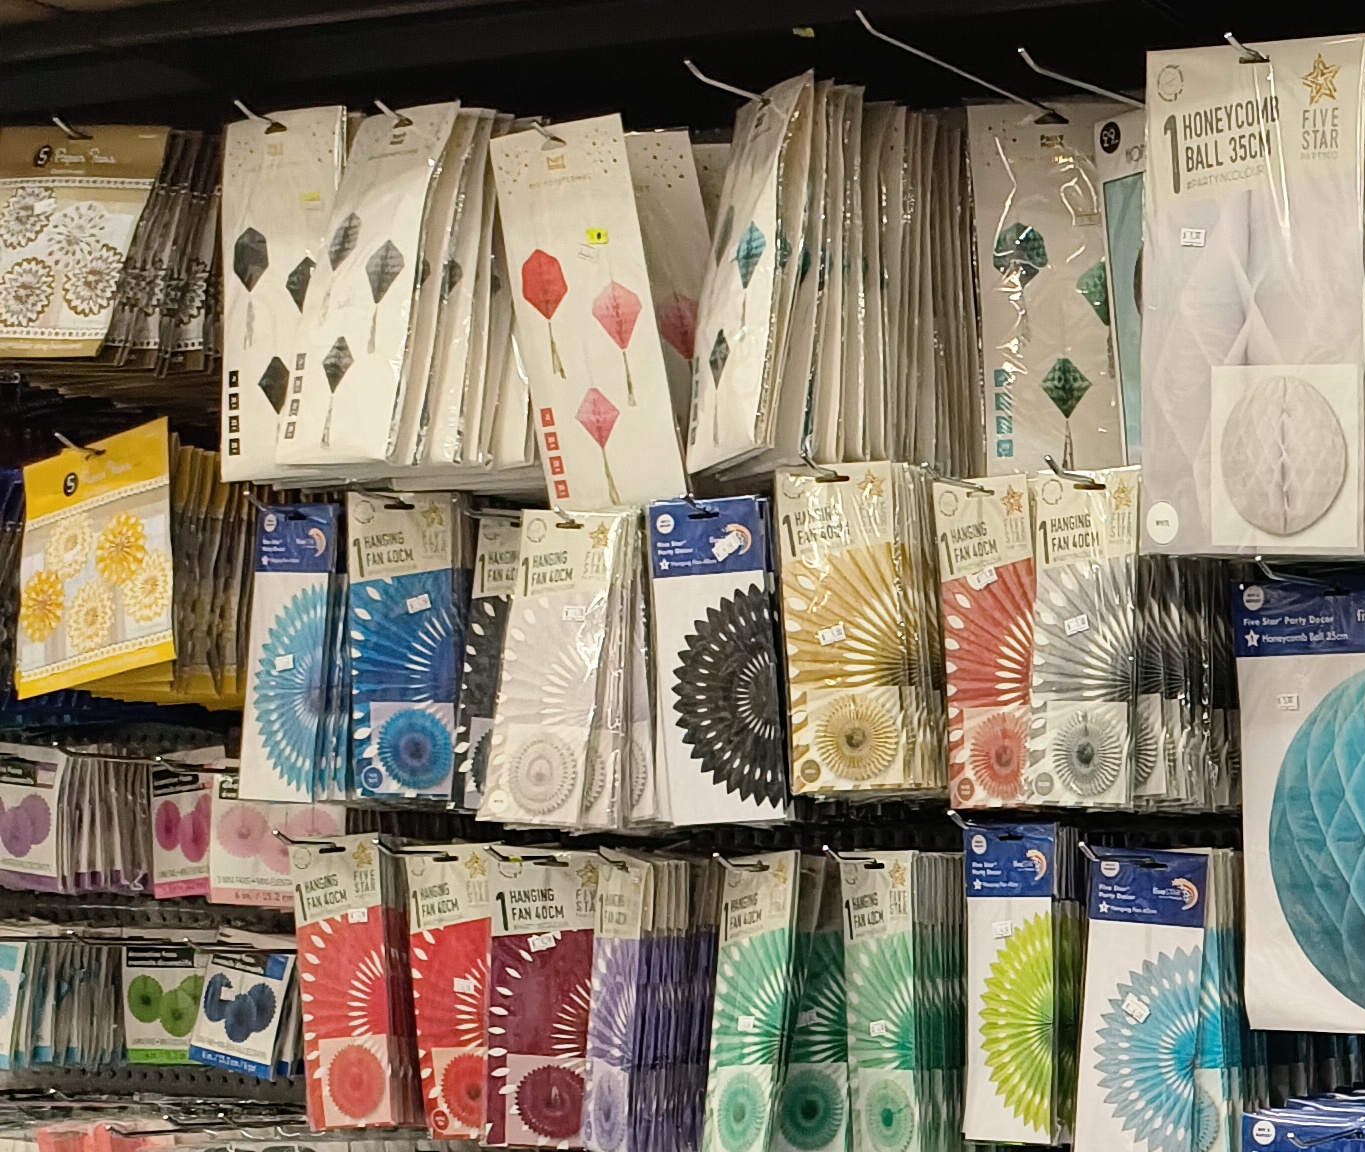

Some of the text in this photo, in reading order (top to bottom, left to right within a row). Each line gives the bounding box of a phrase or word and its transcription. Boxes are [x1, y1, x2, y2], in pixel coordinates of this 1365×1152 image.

[1301, 107, 1340, 131] FIVE
[1163, 97, 1280, 194] 1 HONEYCOMB
[1186, 129, 1271, 173] BALL 35CM
[1301, 128, 1340, 151] STAR
[1039, 513, 1091, 564] 1 HANGING
[1052, 531, 1099, 552] FAN 40CM
[353, 537, 365, 578] 1
[366, 550, 385, 567] FAN
[496, 888, 554, 932] 1 HANGING
[512, 904, 565, 921] FAN 40CM
